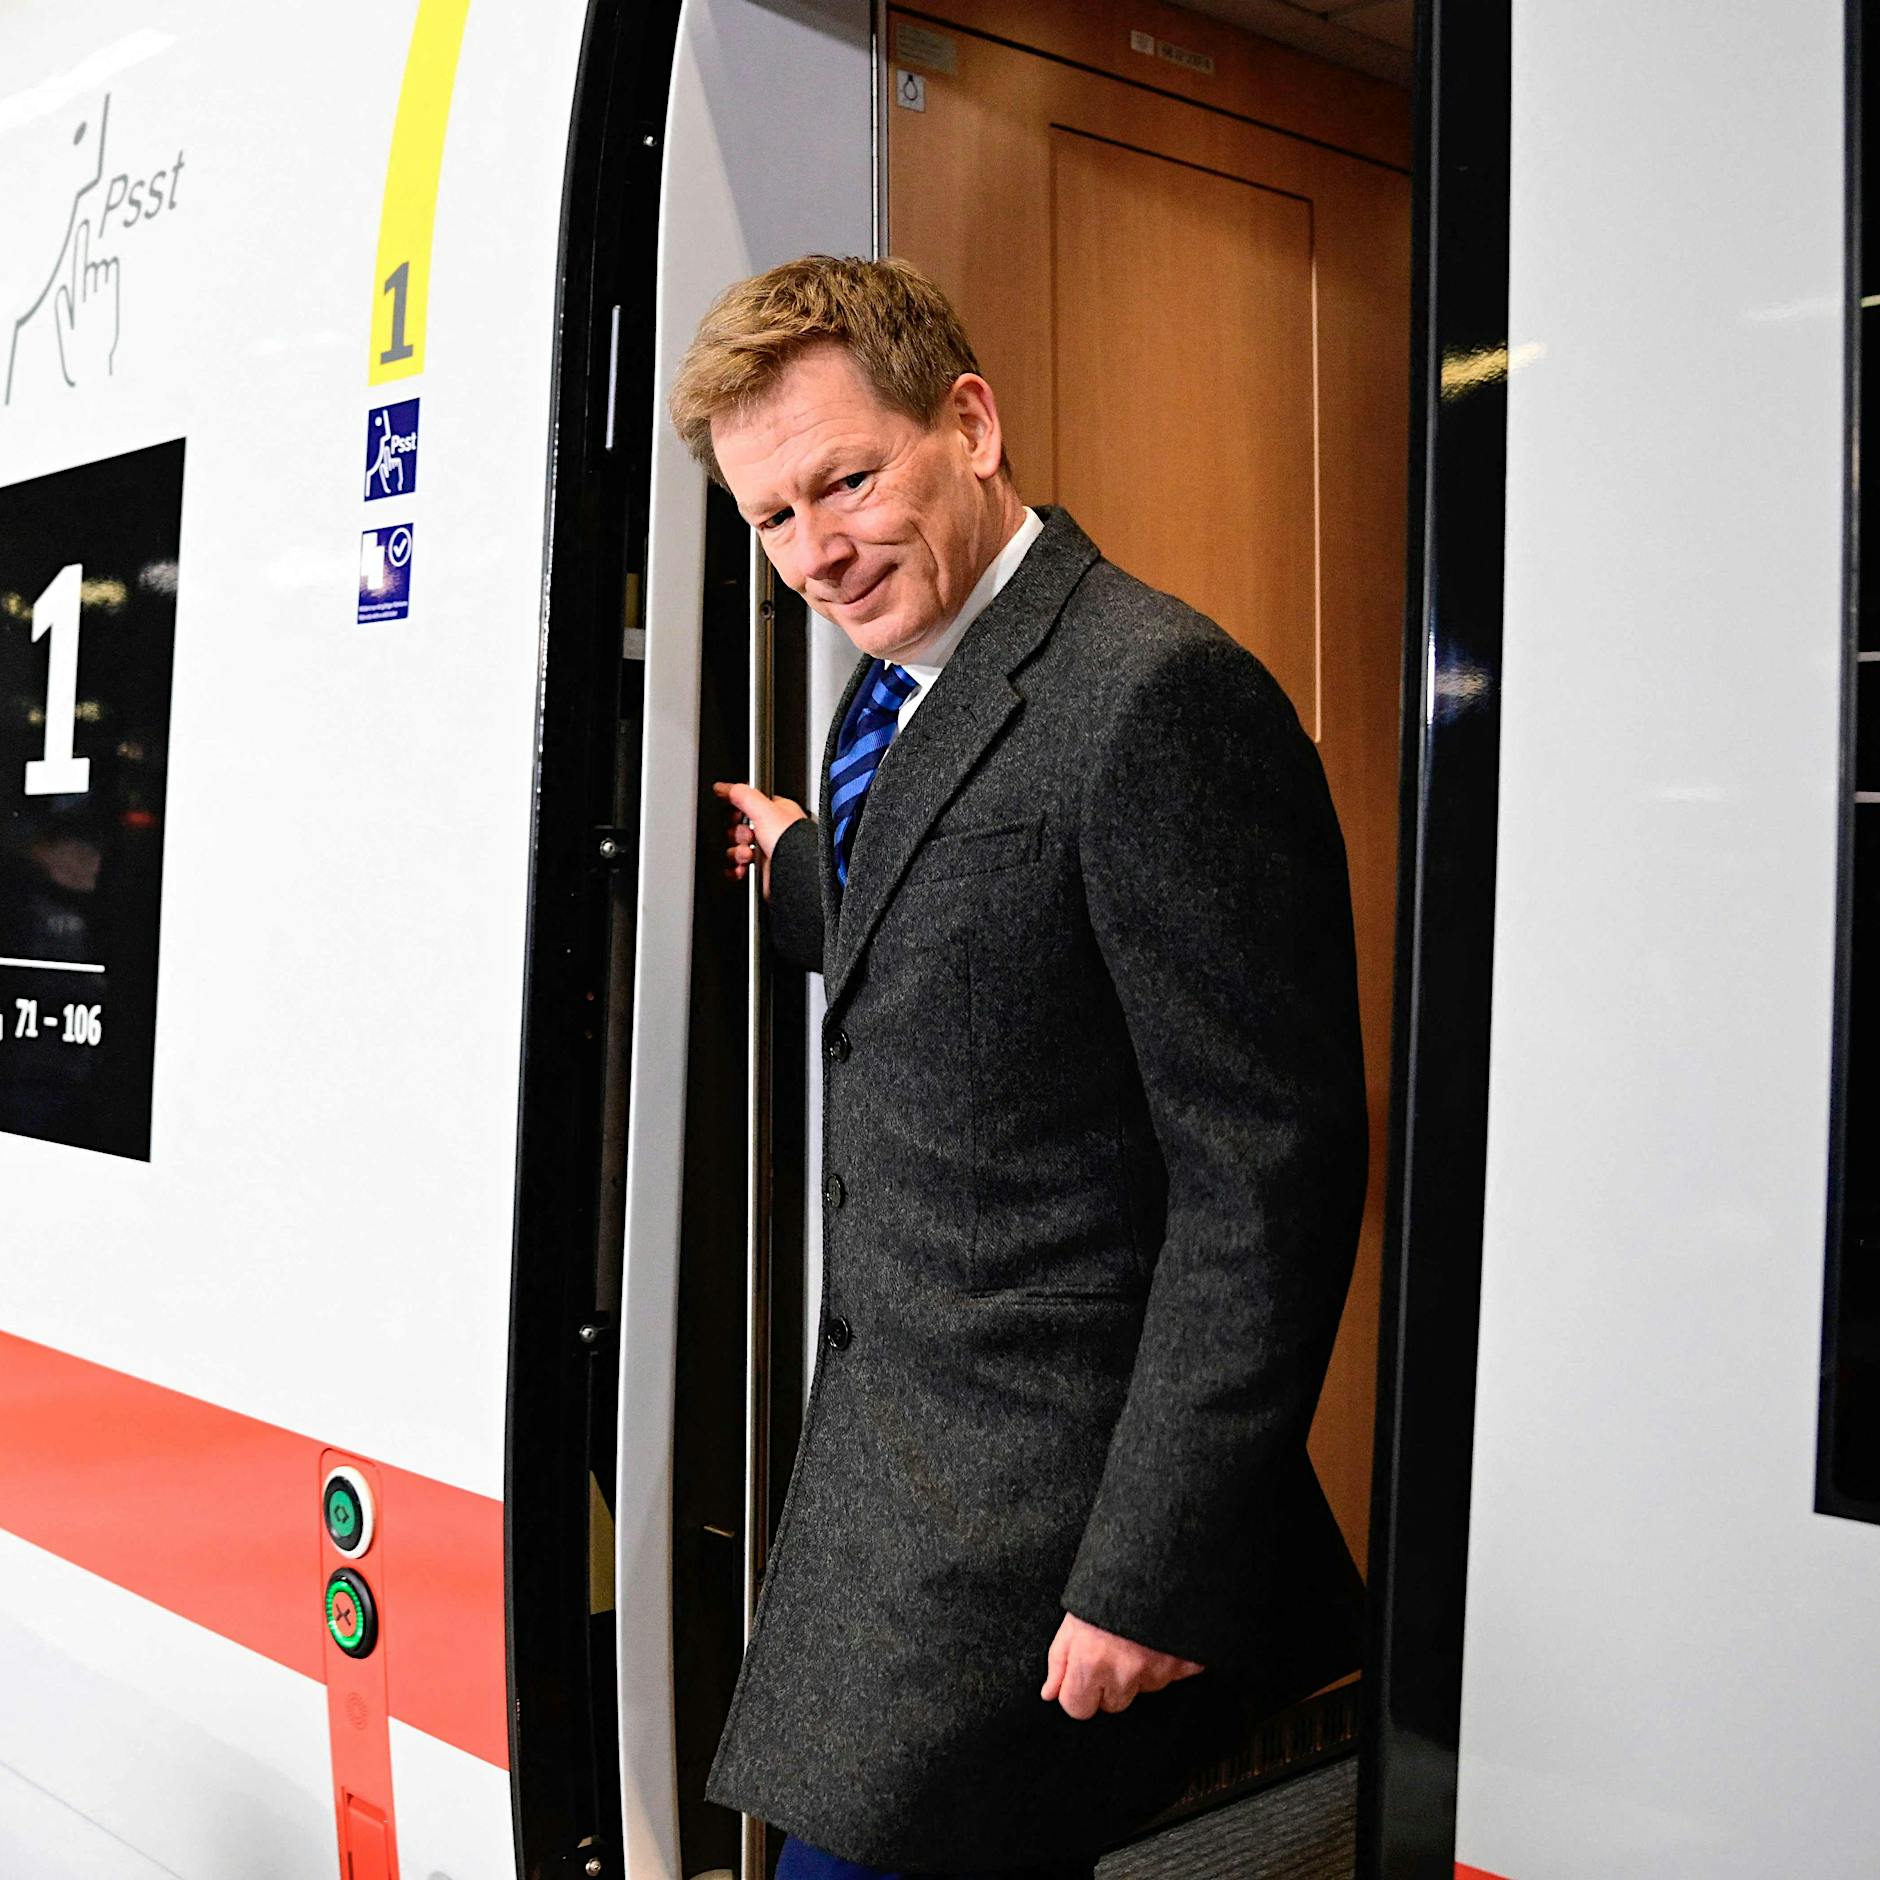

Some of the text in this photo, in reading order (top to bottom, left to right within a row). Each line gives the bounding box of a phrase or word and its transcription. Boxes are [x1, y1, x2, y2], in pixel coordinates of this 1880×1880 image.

[99, 150, 185, 239] Psst
[380, 260, 414, 365] 1
[390, 431, 417, 455] Psst
[24, 563, 91, 795] 1
